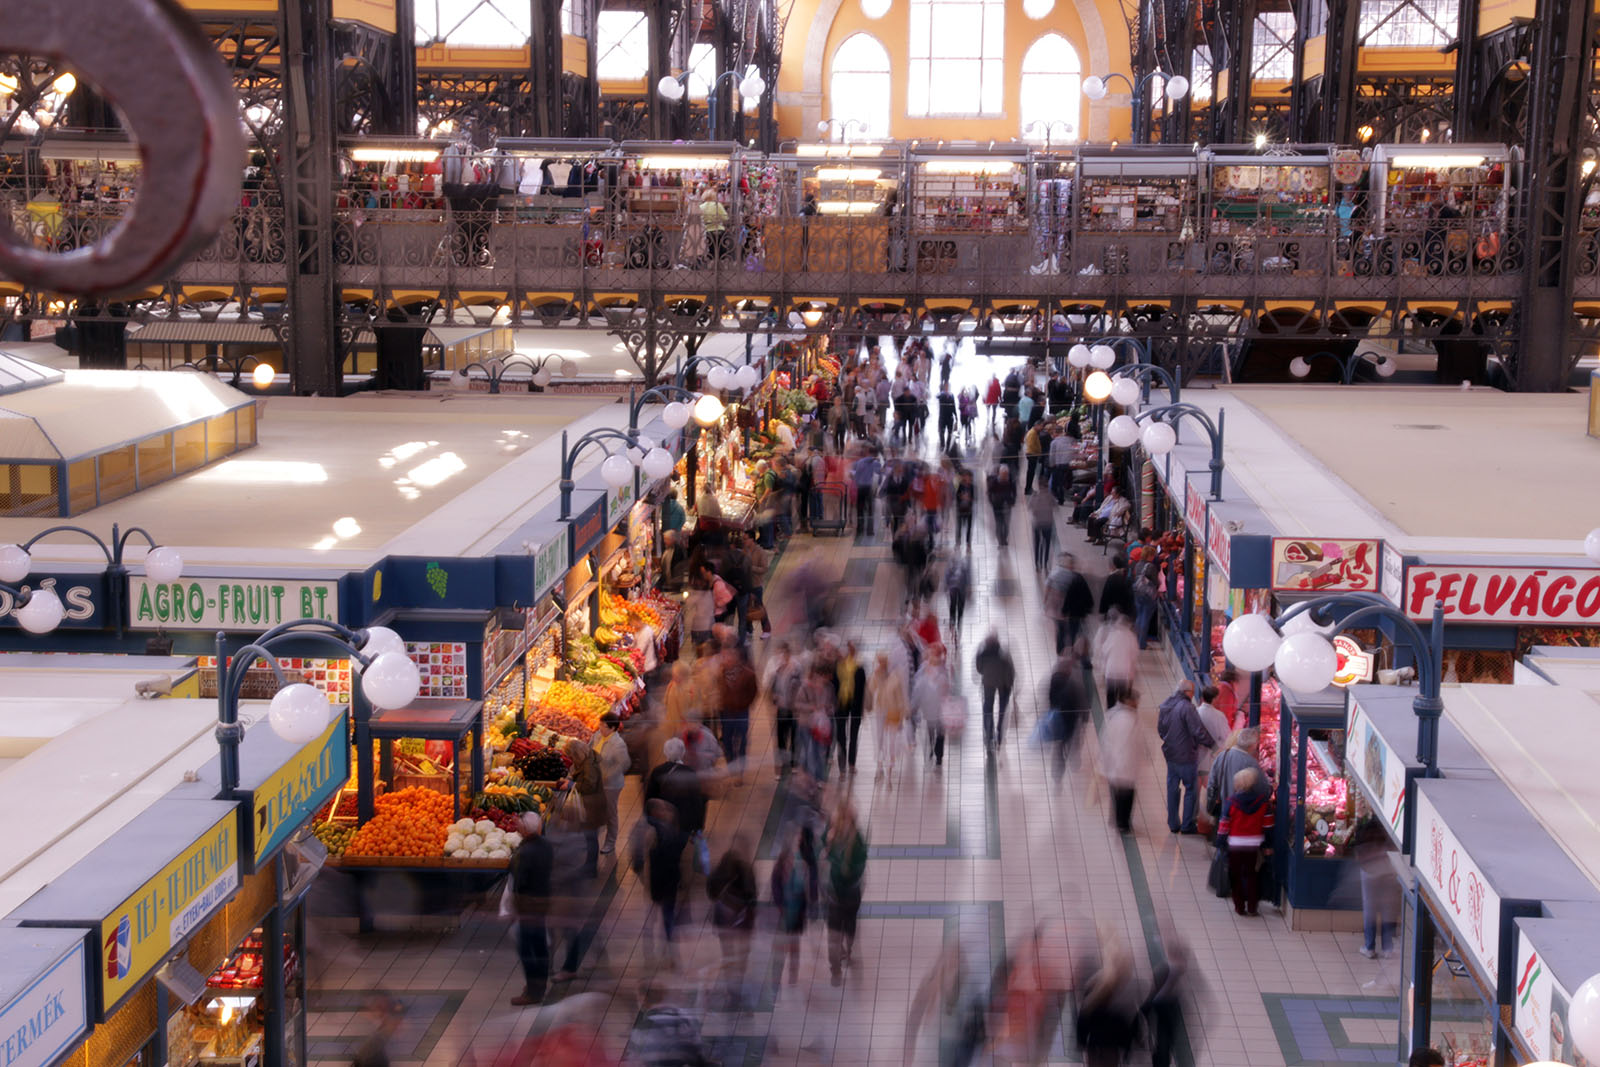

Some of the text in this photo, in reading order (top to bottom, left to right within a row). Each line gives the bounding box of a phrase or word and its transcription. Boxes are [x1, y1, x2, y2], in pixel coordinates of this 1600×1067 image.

[136, 582, 332, 624] AGRO-FRUIT BT.
[1410, 570, 1600, 617] FELVÁGO
[134, 888, 158, 945] TEJ
